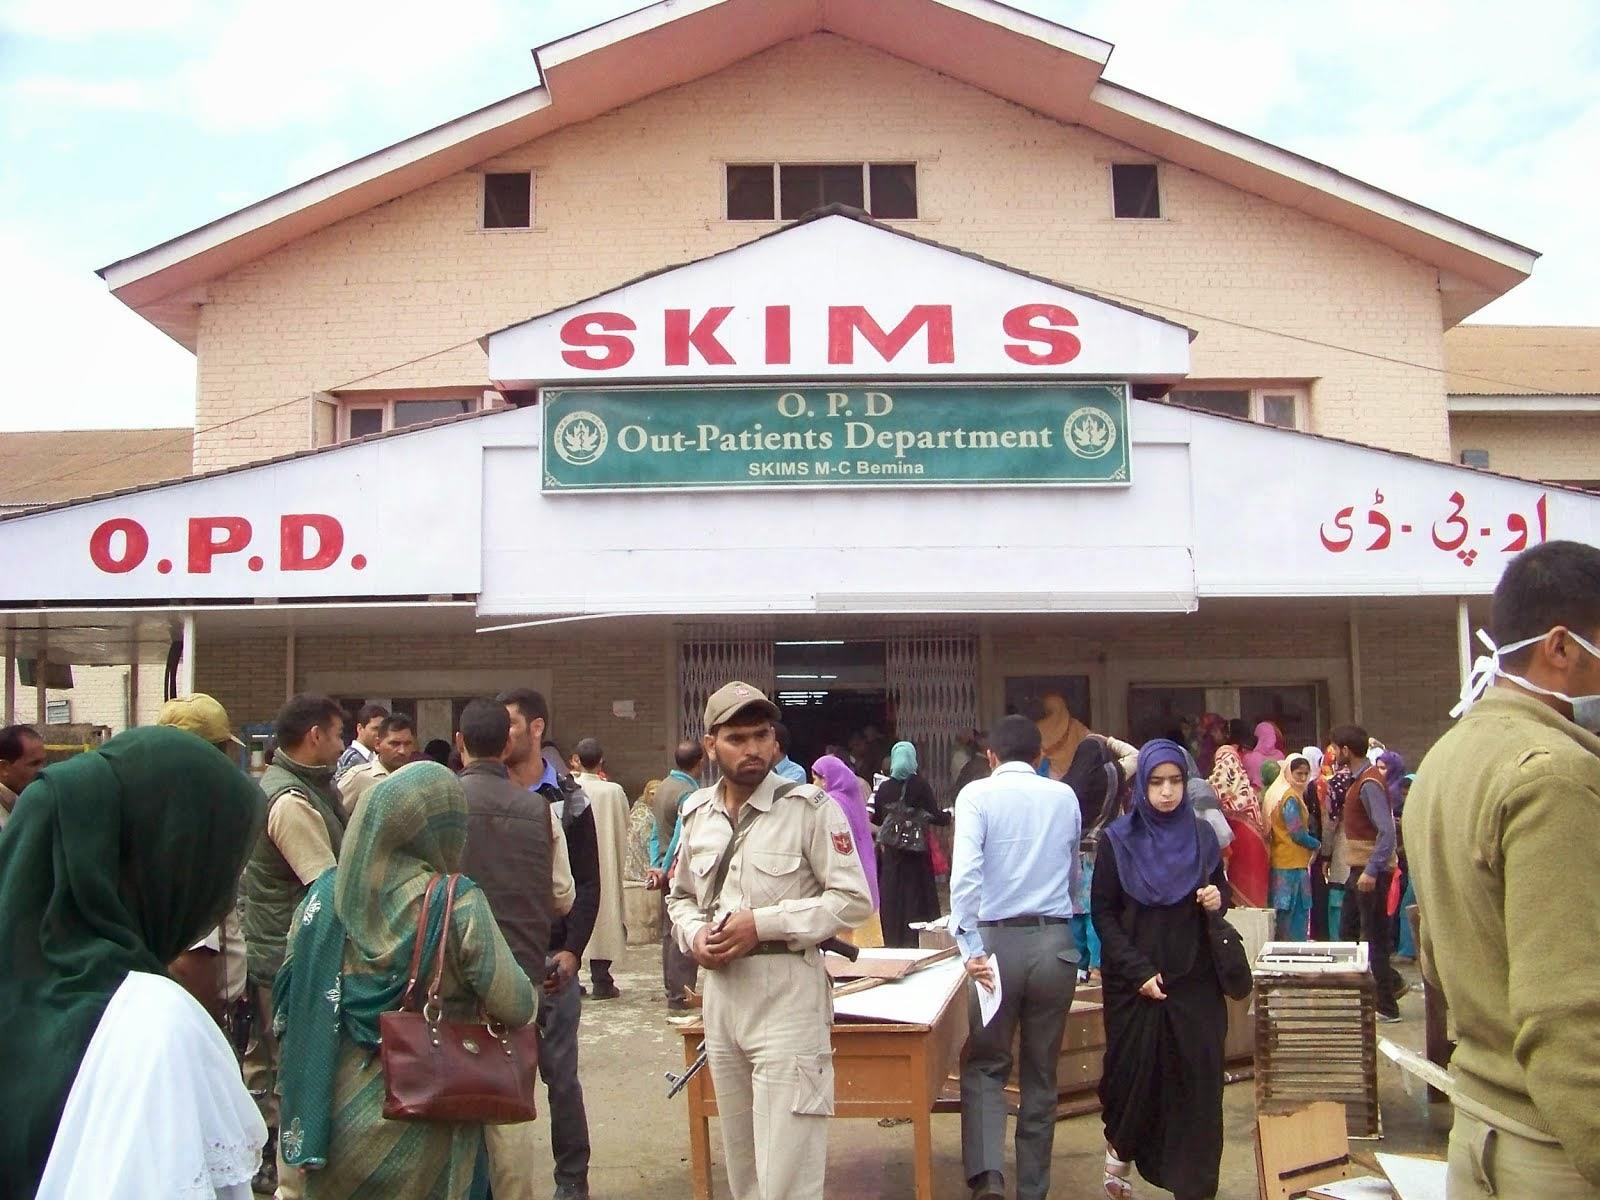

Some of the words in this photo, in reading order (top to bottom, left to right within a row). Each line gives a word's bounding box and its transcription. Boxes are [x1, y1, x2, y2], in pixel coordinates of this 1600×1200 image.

[560, 303, 1081, 371] SKIMS
[617, 422, 833, 453] Out-Patients
[844, 421, 1054, 458] Department
[748, 462, 809, 476] SKIMS
[815, 461, 851, 475] M-C
[856, 460, 925, 474] Bemina
[89, 513, 367, 574] O.P.D.
